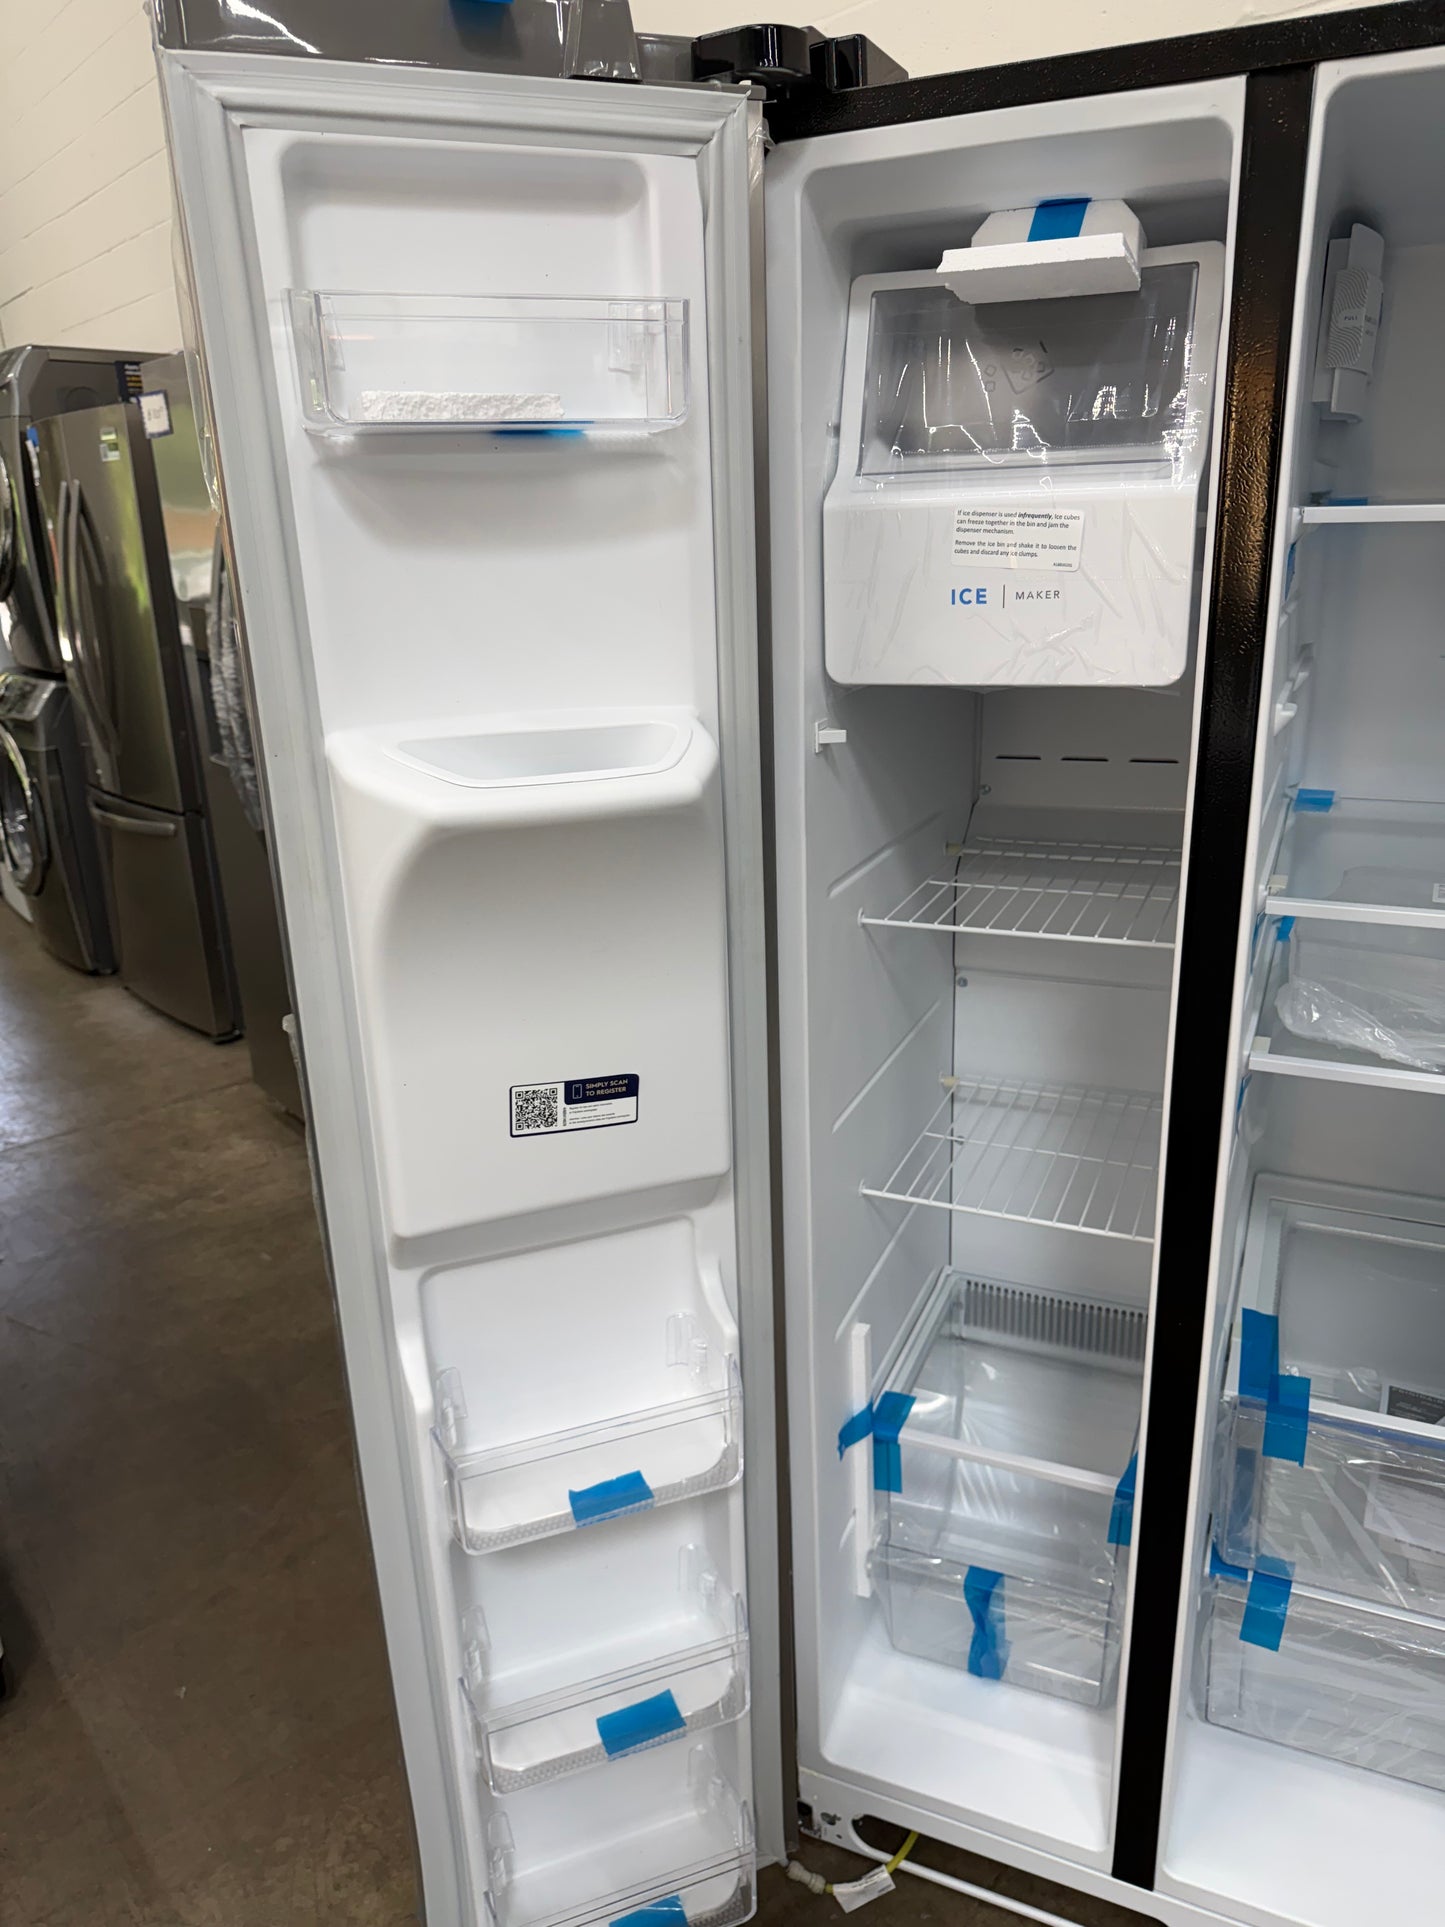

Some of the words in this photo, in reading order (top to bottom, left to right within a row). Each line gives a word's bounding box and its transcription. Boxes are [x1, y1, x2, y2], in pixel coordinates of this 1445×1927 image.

[1018, 512, 1054, 520] infrequently,
[956, 526, 982, 534] dispenser
[951, 588, 988, 605] ICE
[1015, 590, 1060, 600] MAKER
[585, 1081, 608, 1089] SIMPLY
[597, 1086, 627, 1095] REGISTER
